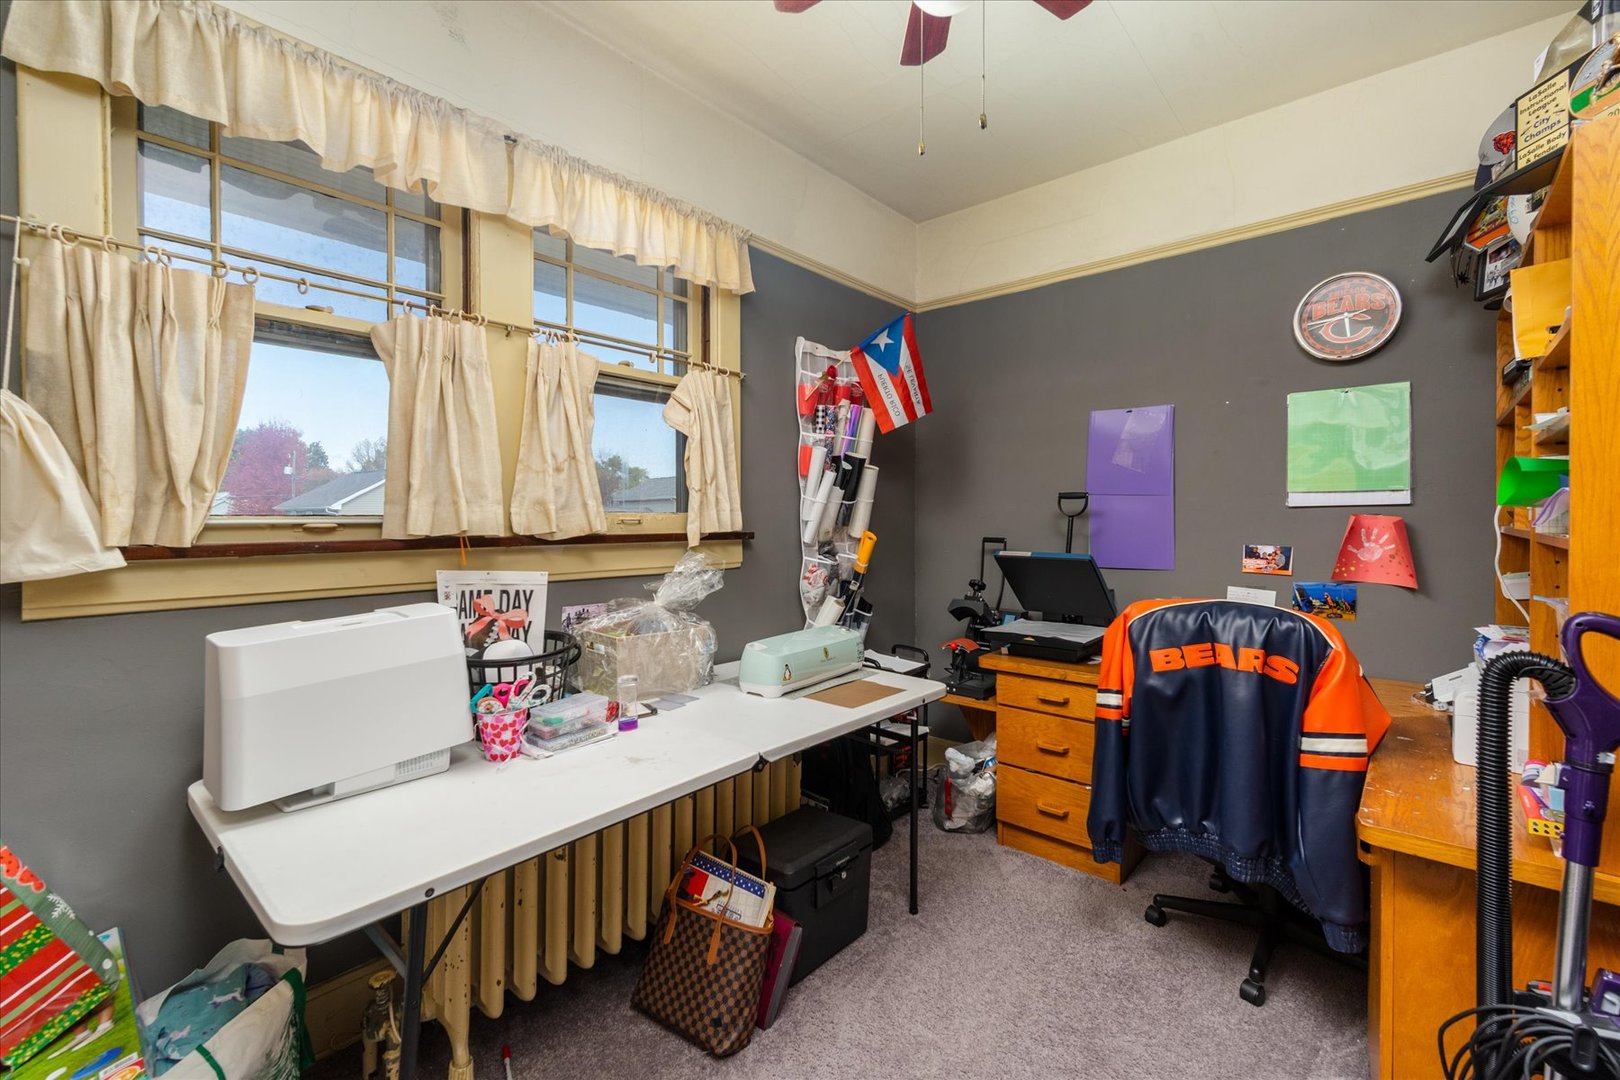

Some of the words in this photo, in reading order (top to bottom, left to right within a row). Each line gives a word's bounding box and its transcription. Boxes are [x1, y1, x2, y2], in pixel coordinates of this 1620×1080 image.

[1520, 82, 1567, 115] Instructional
[1528, 81, 1557, 103] LaSalle
[1528, 96, 1557, 117] League
[1523, 119, 1562, 143] Champs
[1533, 115, 1551, 129] City
[1519, 143, 1545, 161] LaSalle
[1546, 131, 1567, 146] Body
[1533, 142, 1560, 160] Fender
[1311, 292, 1386, 321] BEARS
[1149, 642, 1300, 684] BEARS
